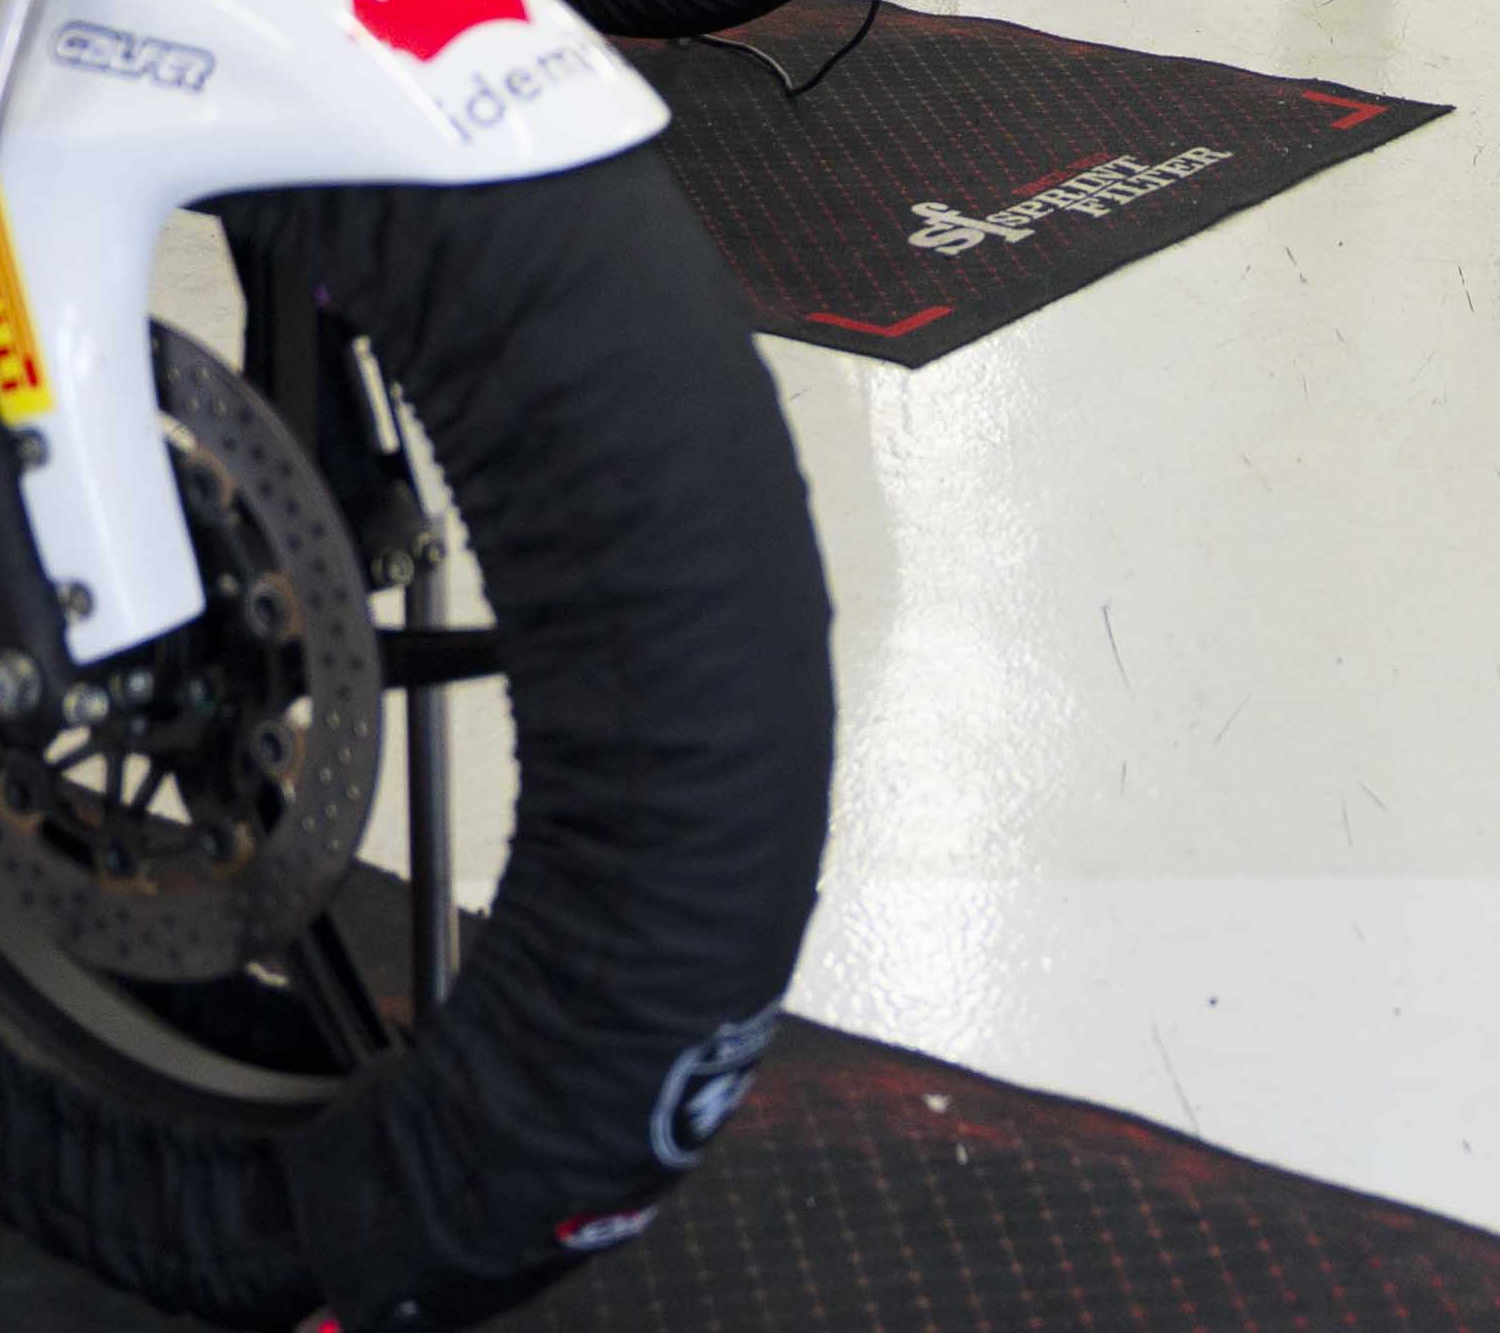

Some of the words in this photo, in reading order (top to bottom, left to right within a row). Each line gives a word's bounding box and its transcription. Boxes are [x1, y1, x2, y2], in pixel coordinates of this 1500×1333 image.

[54, 21, 218, 95] GALFER
[444, 31, 598, 146] idem
[985, 153, 1153, 230] SPRINT
[1071, 145, 1235, 220] FILTER
